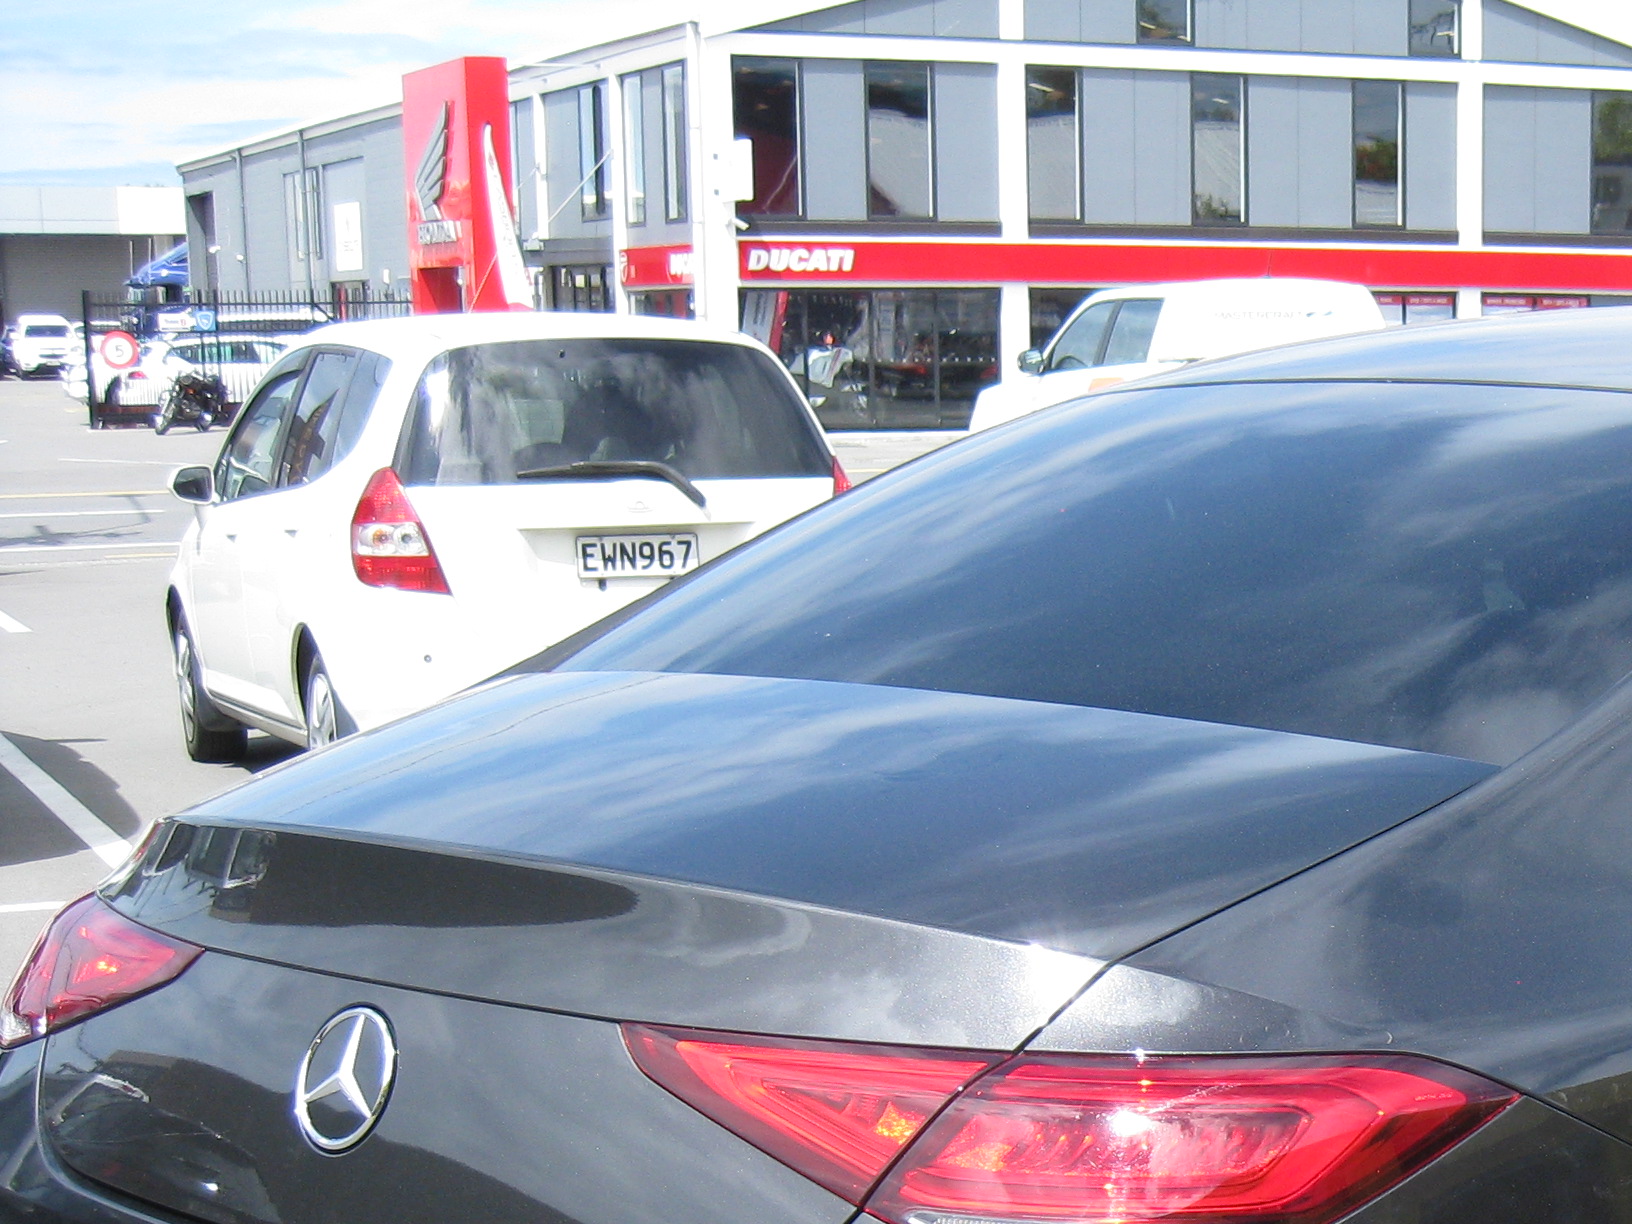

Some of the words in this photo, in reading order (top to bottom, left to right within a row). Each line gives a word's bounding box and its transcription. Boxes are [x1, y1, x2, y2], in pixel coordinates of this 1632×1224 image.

[747, 249, 855, 272] DUCATI
[115, 345, 124, 357] 5
[581, 540, 693, 572] EWN967
